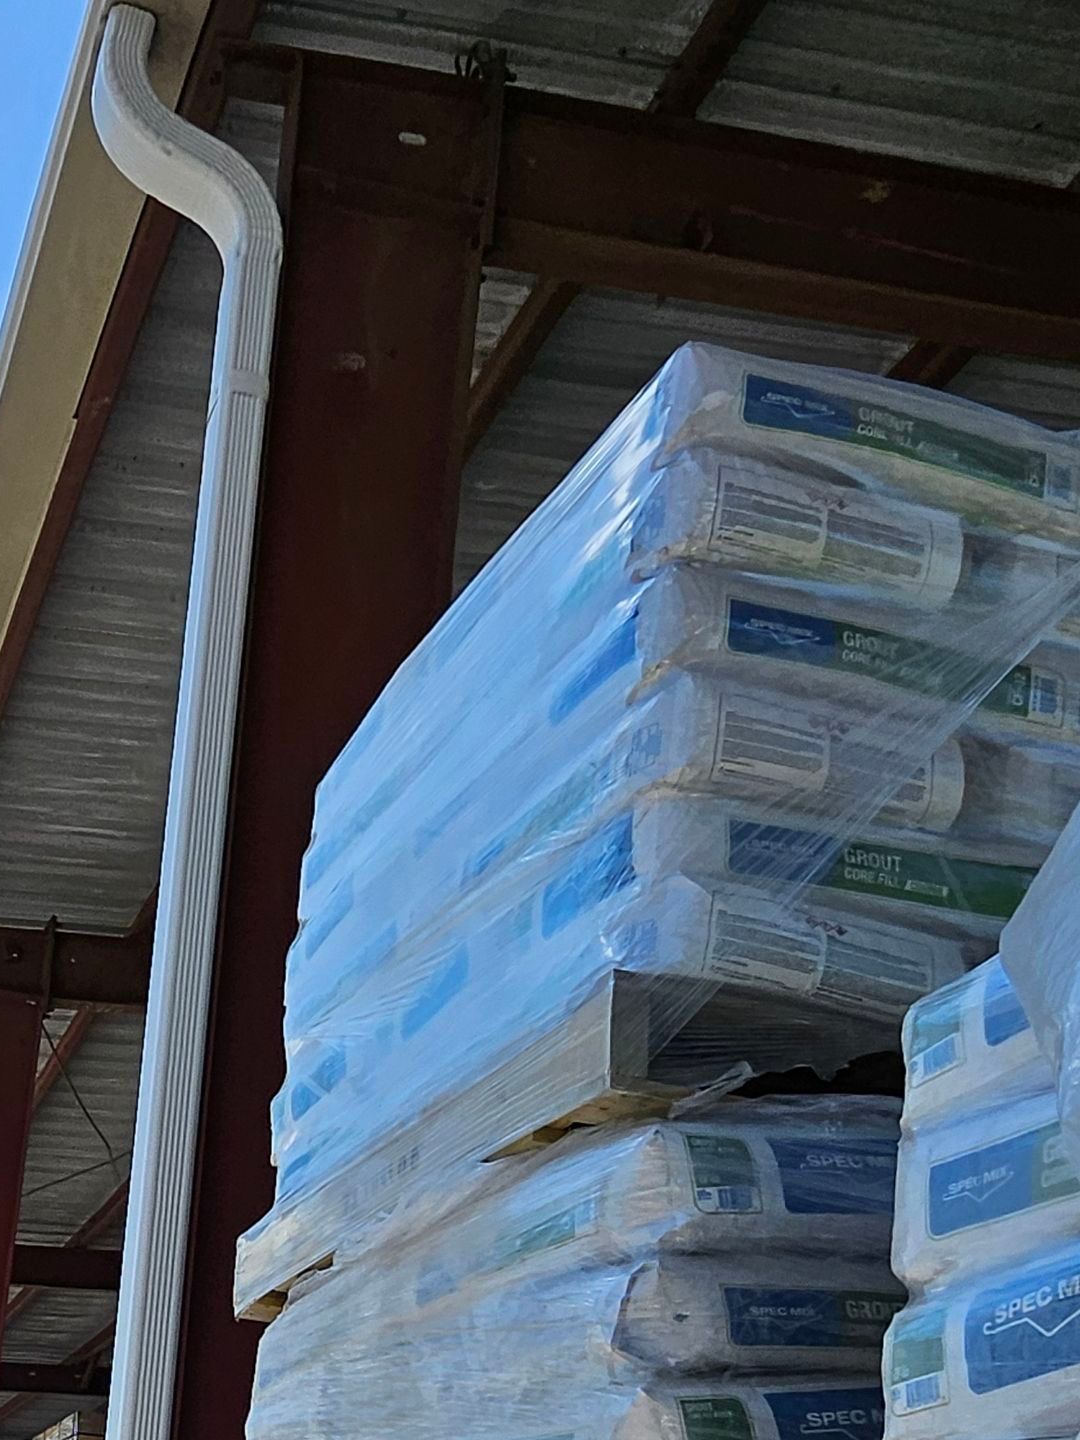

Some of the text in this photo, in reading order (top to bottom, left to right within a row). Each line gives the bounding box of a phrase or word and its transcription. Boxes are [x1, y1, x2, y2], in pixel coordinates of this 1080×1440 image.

[843, 846, 902, 873] GROUT
[843, 866, 875, 882] CORE
[947, 1164, 1011, 1196] SPEC MIX
[749, 1305, 788, 1317] SPEC
[994, 1285, 1053, 1324] SPEC
[806, 1410, 866, 1427] SPEC
